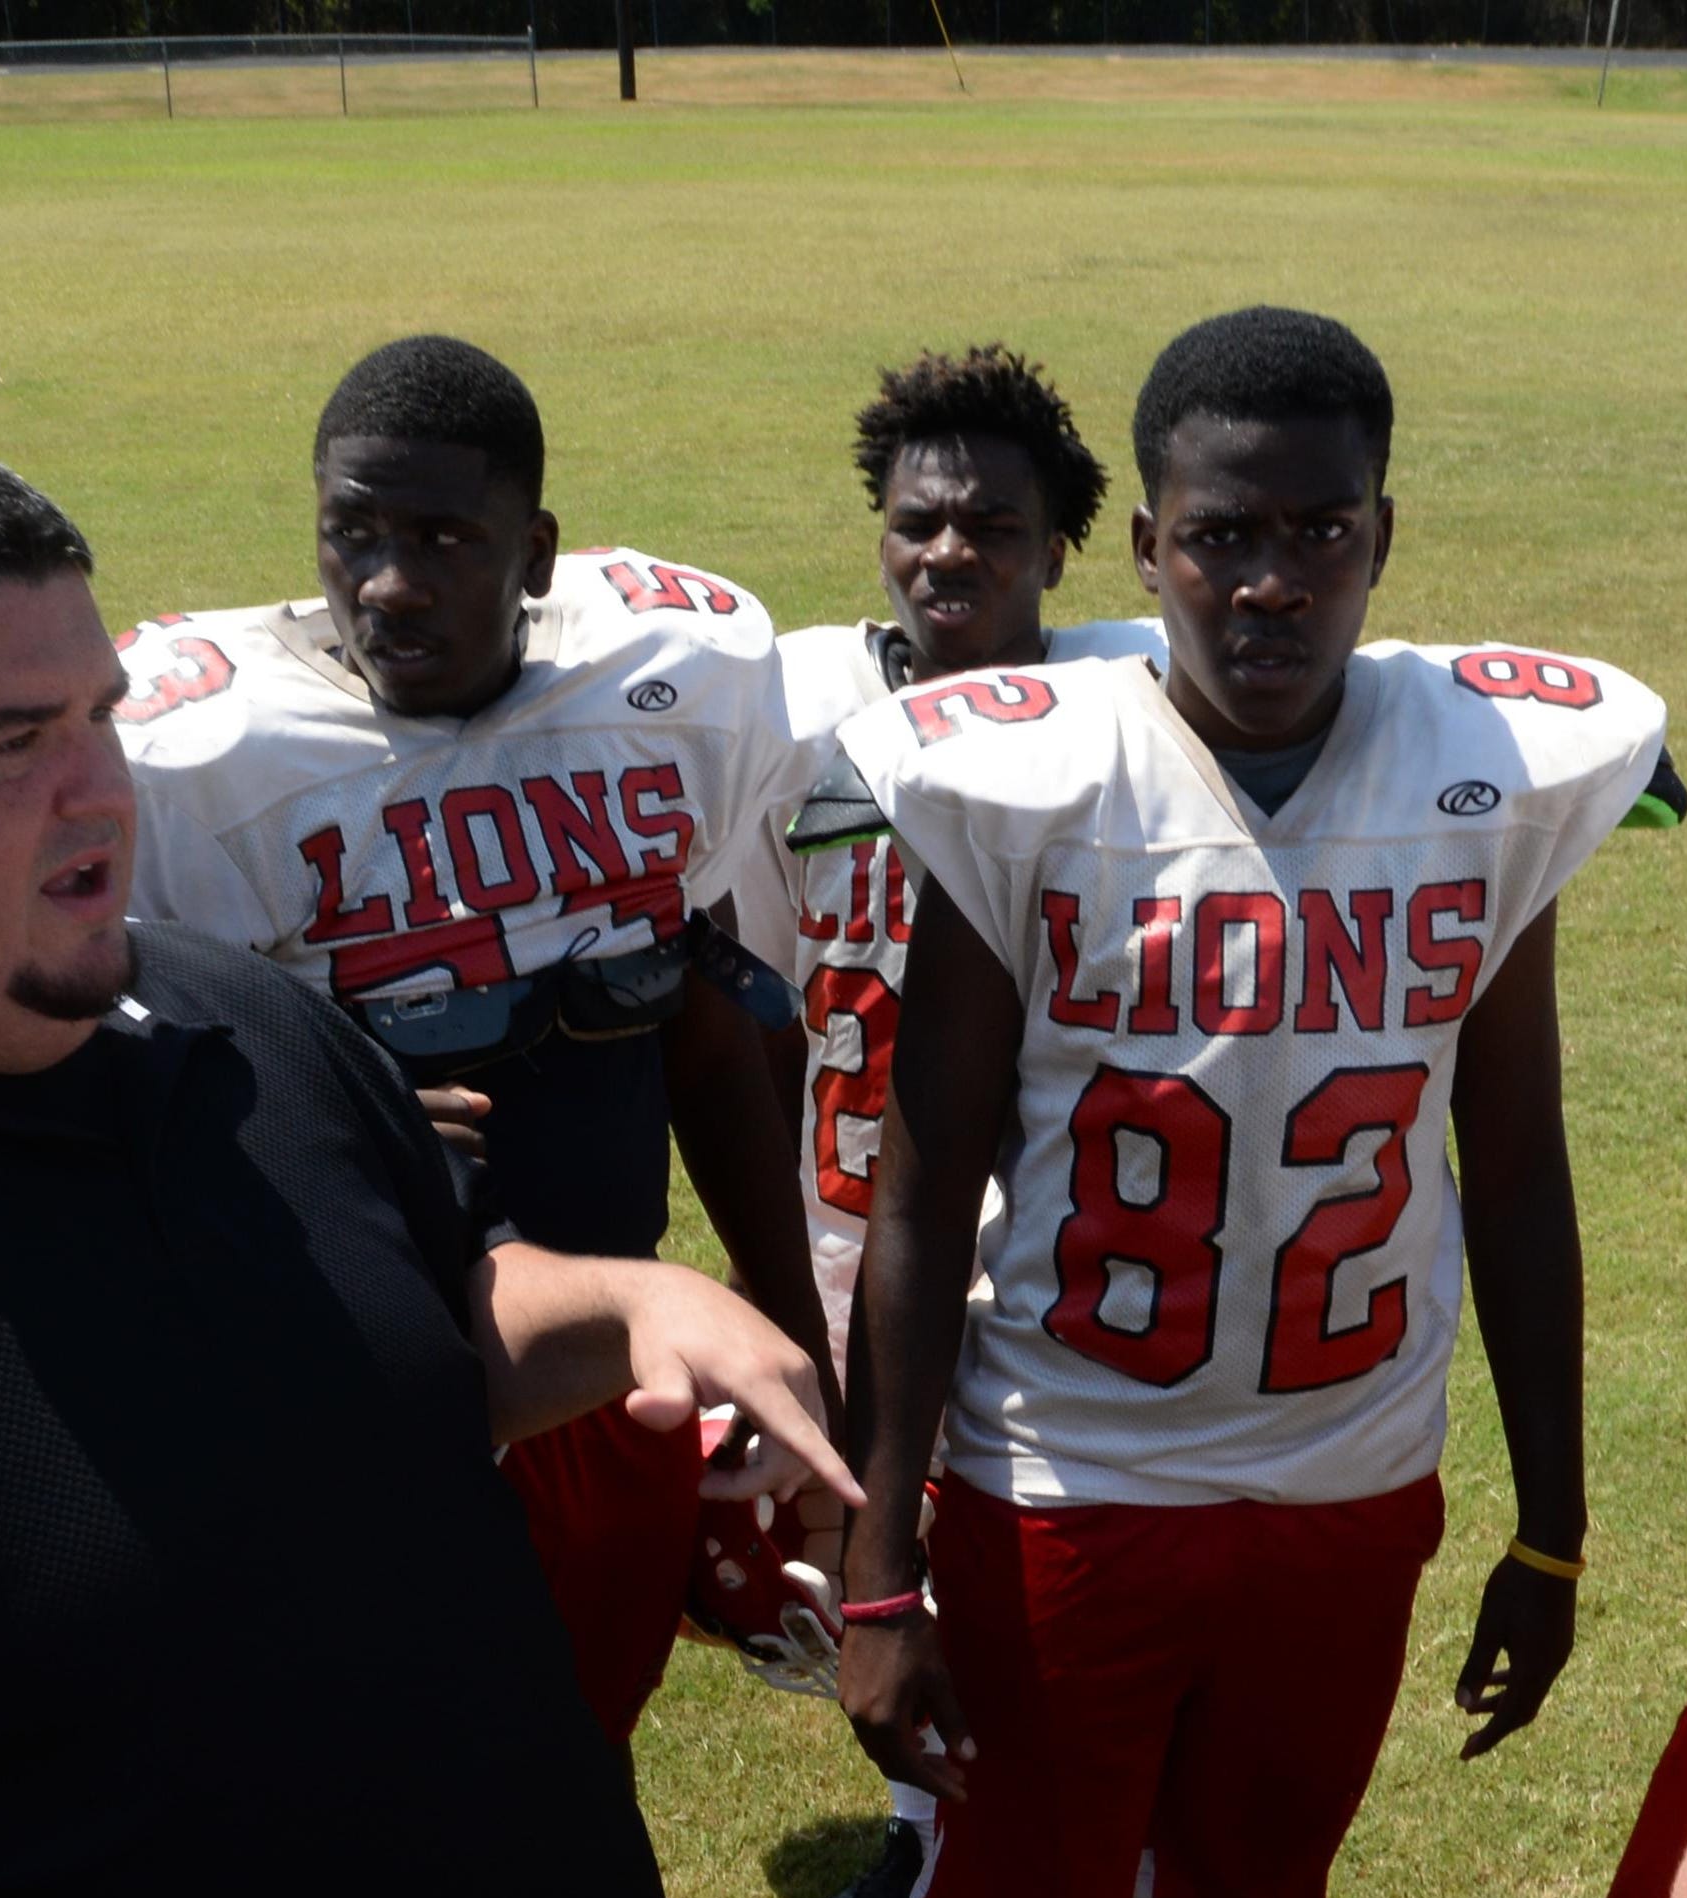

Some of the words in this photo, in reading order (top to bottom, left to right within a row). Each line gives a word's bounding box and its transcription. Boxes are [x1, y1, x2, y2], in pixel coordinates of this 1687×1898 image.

[571, 547, 739, 615] 5
[112, 613, 237, 726] 3
[901, 666, 1059, 749] 2
[1453, 650, 1603, 711] 8
[299, 762, 695, 946] LIONS
[1040, 878, 1487, 1037] LIONS
[1041, 1062, 1430, 1394] 82
